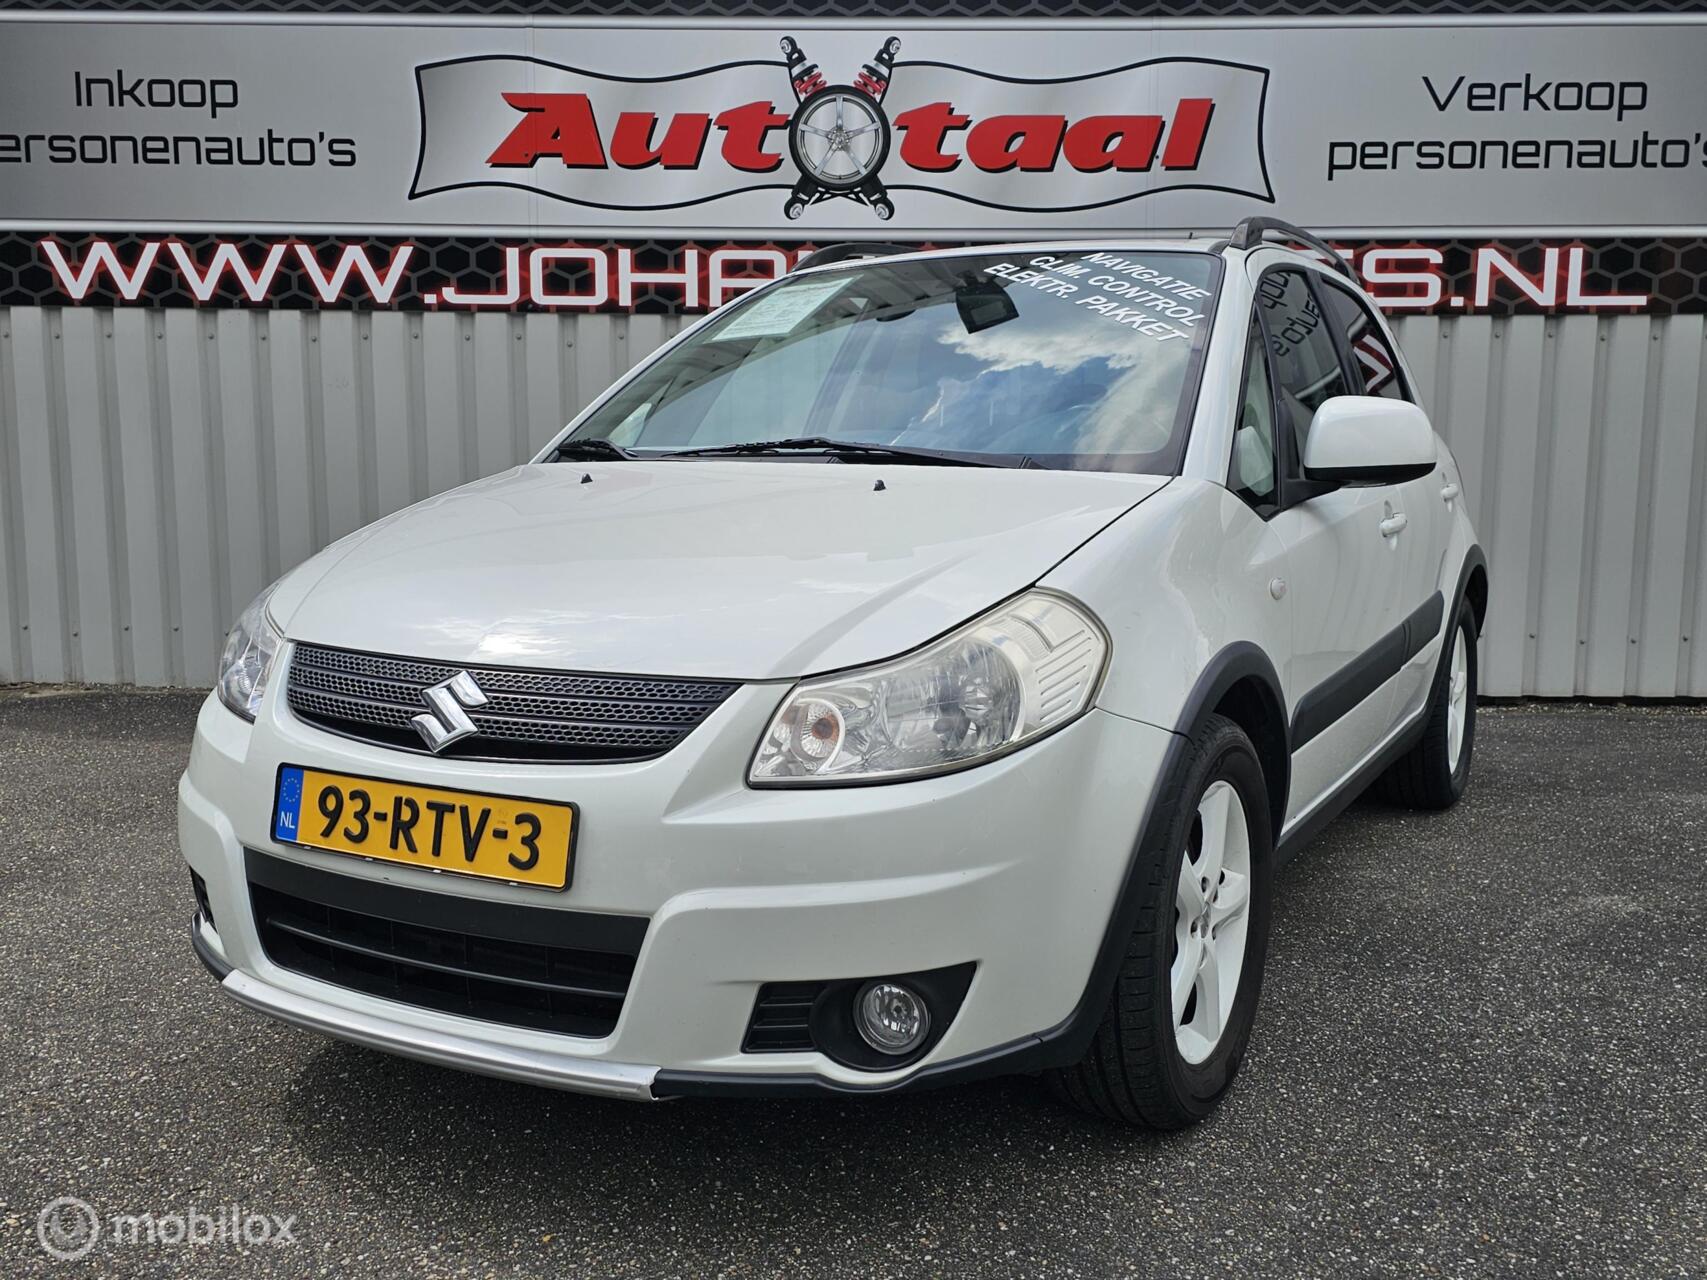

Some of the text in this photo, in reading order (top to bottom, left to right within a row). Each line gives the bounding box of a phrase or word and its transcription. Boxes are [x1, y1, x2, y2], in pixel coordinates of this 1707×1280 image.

[74, 69, 239, 118] Inkoop
[1422, 73, 1648, 121] Verkoop
[0, 129, 357, 167] ersonenauto's
[1327, 130, 1707, 181] personenauto'
[1029, 256, 1205, 327] CLIM. CONTROL
[1081, 252, 1212, 300] NAVIGATIE
[983, 263, 1190, 341] ELEKTR. PAKKET
[280, 811, 295, 829] NL
[318, 785, 542, 870] 93-RTV-3
